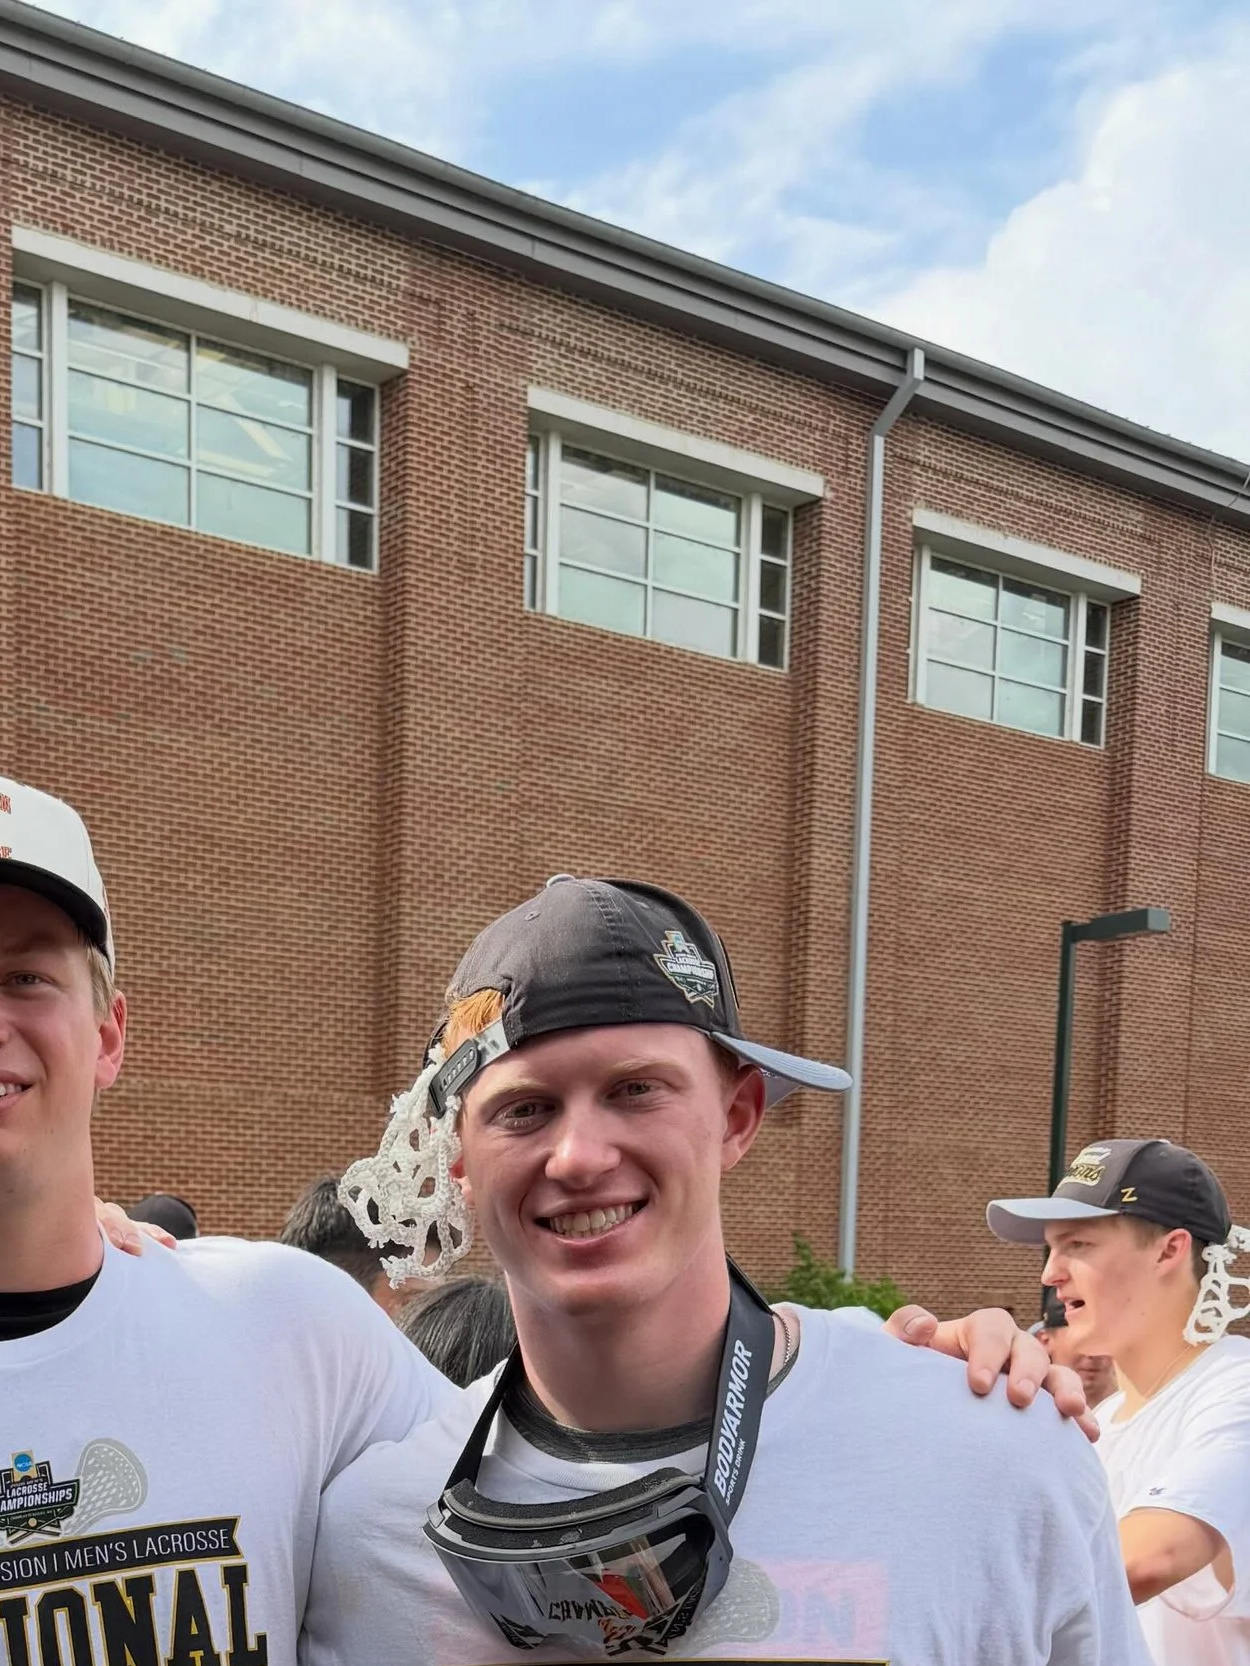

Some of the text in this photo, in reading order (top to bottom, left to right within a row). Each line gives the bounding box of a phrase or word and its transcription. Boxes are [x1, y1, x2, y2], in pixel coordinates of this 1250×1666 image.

[714, 1339, 752, 1498] BODYARMOR
[6, 1481, 48, 1499] LACROSSE
[725, 1438, 746, 1506] SPORTS DRINK
[65, 1541, 128, 1571] MEN'S
[134, 1528, 230, 1559] LACROSSE
